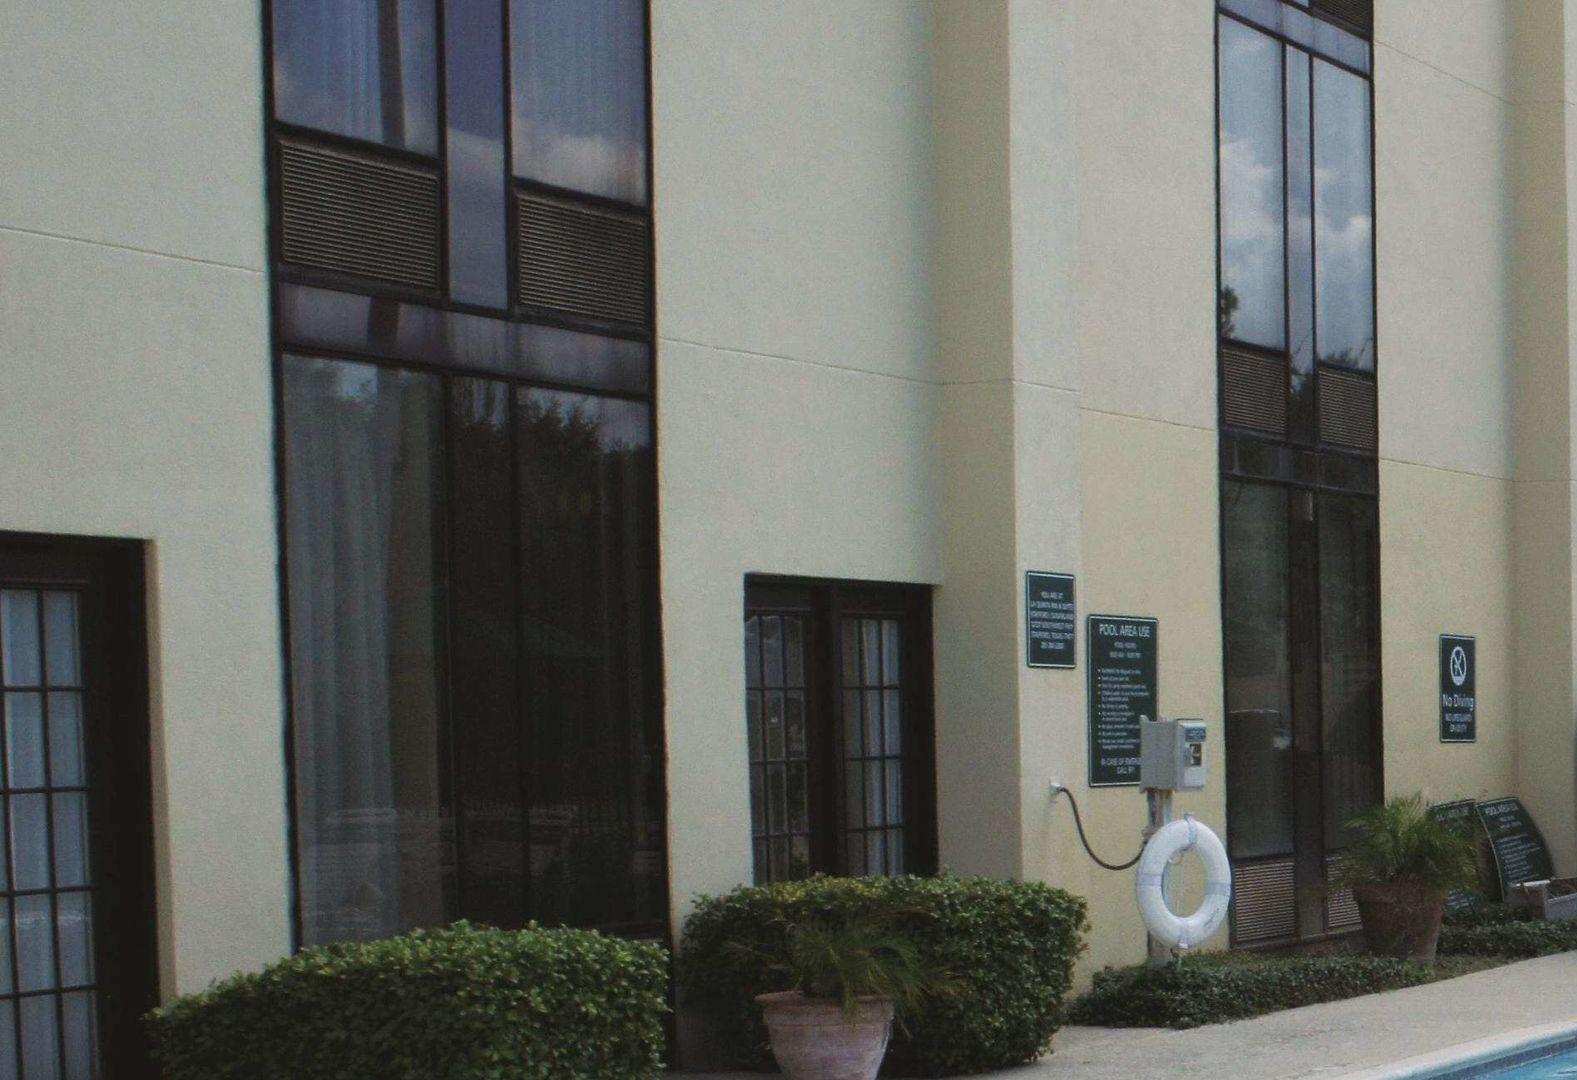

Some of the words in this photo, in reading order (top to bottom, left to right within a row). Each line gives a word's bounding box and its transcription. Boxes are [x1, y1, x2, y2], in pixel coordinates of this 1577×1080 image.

[1099, 624, 1119, 636] POOL
[1120, 624, 1138, 637] AREA
[1138, 625, 1151, 638] USE
[1442, 694, 1453, 708] No
[1454, 694, 1475, 712] Diving
